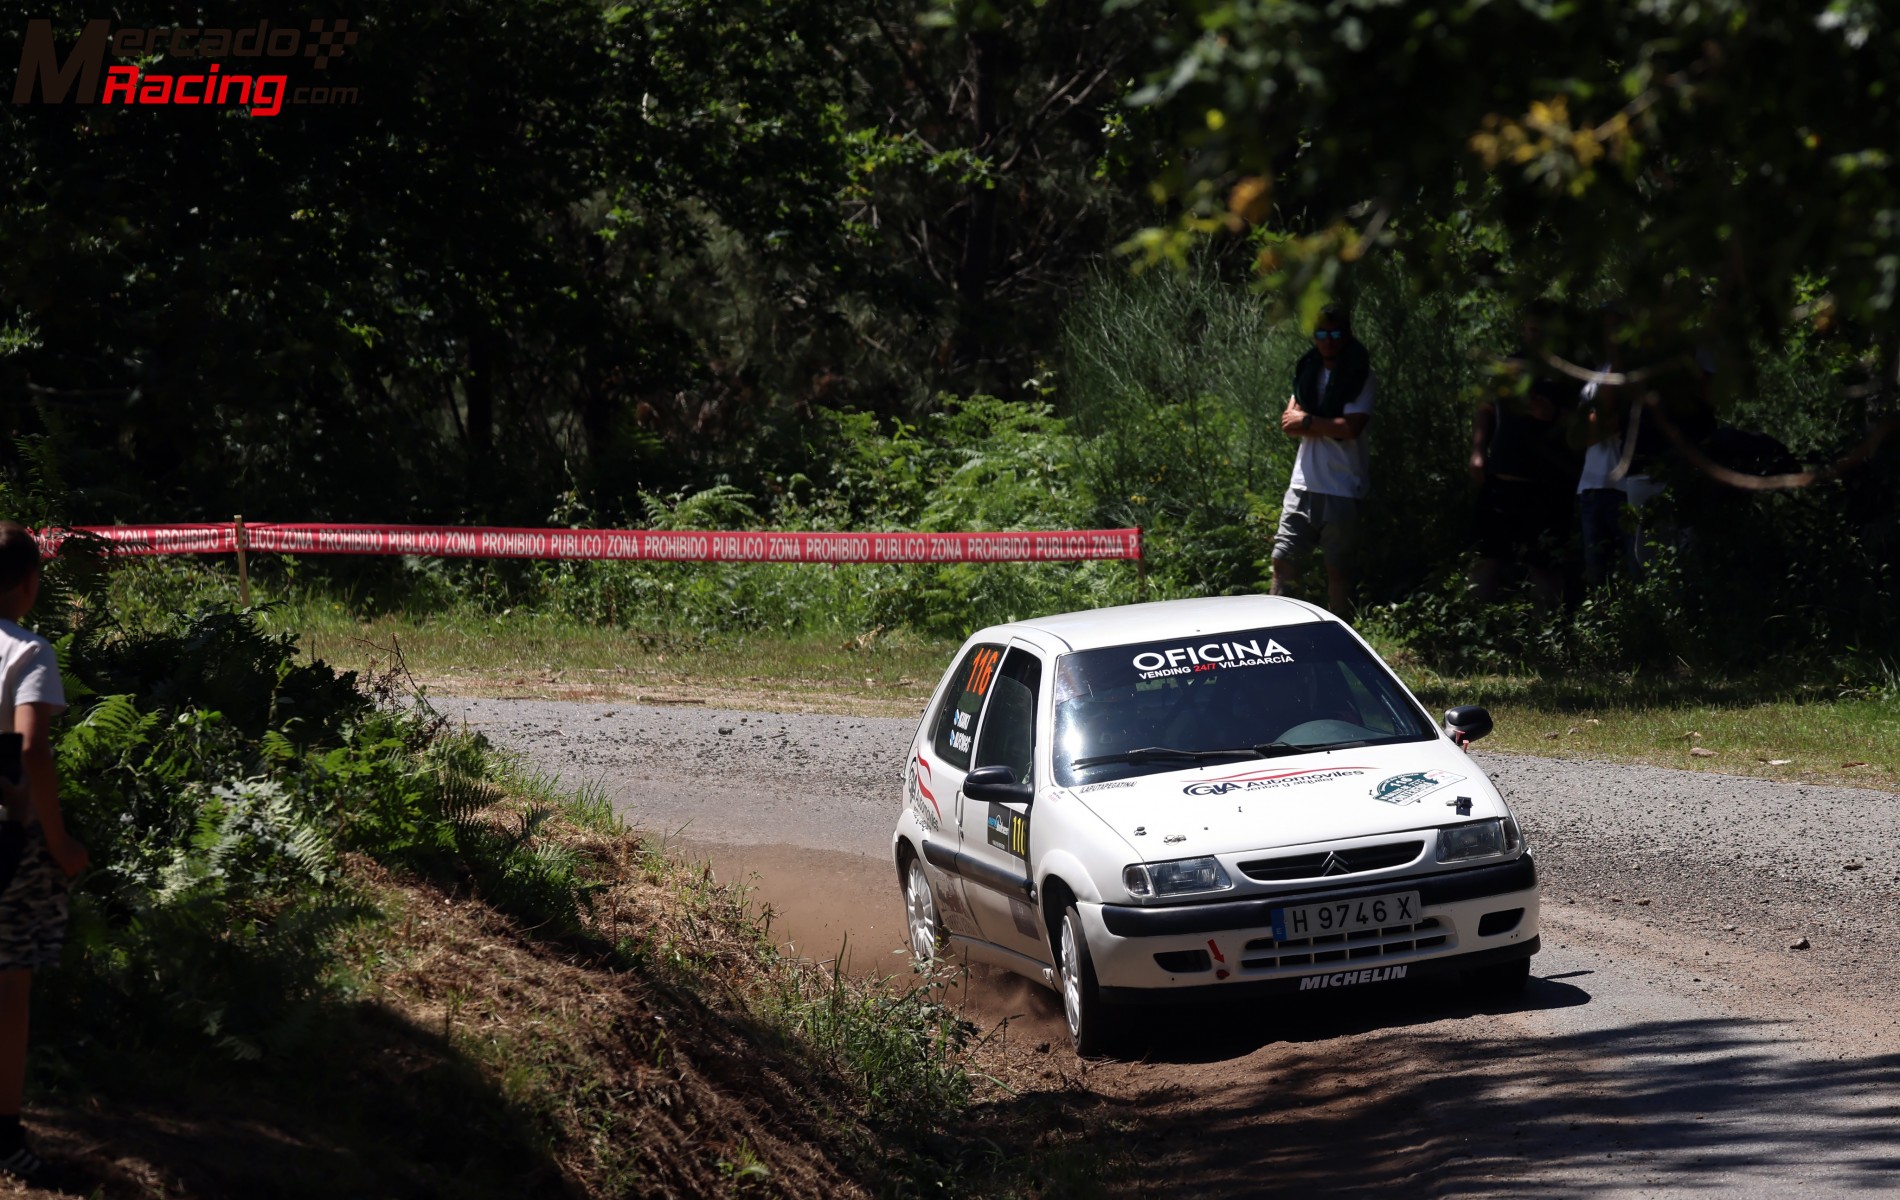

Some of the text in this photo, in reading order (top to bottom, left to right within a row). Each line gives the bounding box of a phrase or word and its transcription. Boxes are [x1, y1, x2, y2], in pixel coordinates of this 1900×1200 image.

[155, 528, 219, 550] PROHIBIDO
[281, 528, 314, 550] ZONA
[319, 529, 383, 551] PROHIBIDO
[388, 531, 439, 551] PUBLICO
[445, 532, 476, 554] ZONA
[482, 532, 545, 556] PROHIBIDO
[551, 533, 600, 557] PUBLICO
[607, 535, 639, 558] ZONA
[644, 536, 707, 559] PROHIBIDO
[713, 536, 763, 560] PUBLICO
[769, 537, 800, 560] ZONA
[806, 537, 869, 561] PROHIBIDO
[875, 537, 925, 561] PUBLICO
[931, 538, 962, 560] ZONA
[968, 537, 1030, 560] PROHIBIDO
[1036, 536, 1086, 559] PUBLICO
[1092, 535, 1124, 557] ZONA
[1133, 638, 1292, 671] OFICINA
[1139, 655, 1294, 680] VENDING 24/7 VILAGARCÍA
[966, 648, 998, 695] 116
[1292, 896, 1413, 934] H 9746 X
[1300, 964, 1408, 991] MICHELIN
